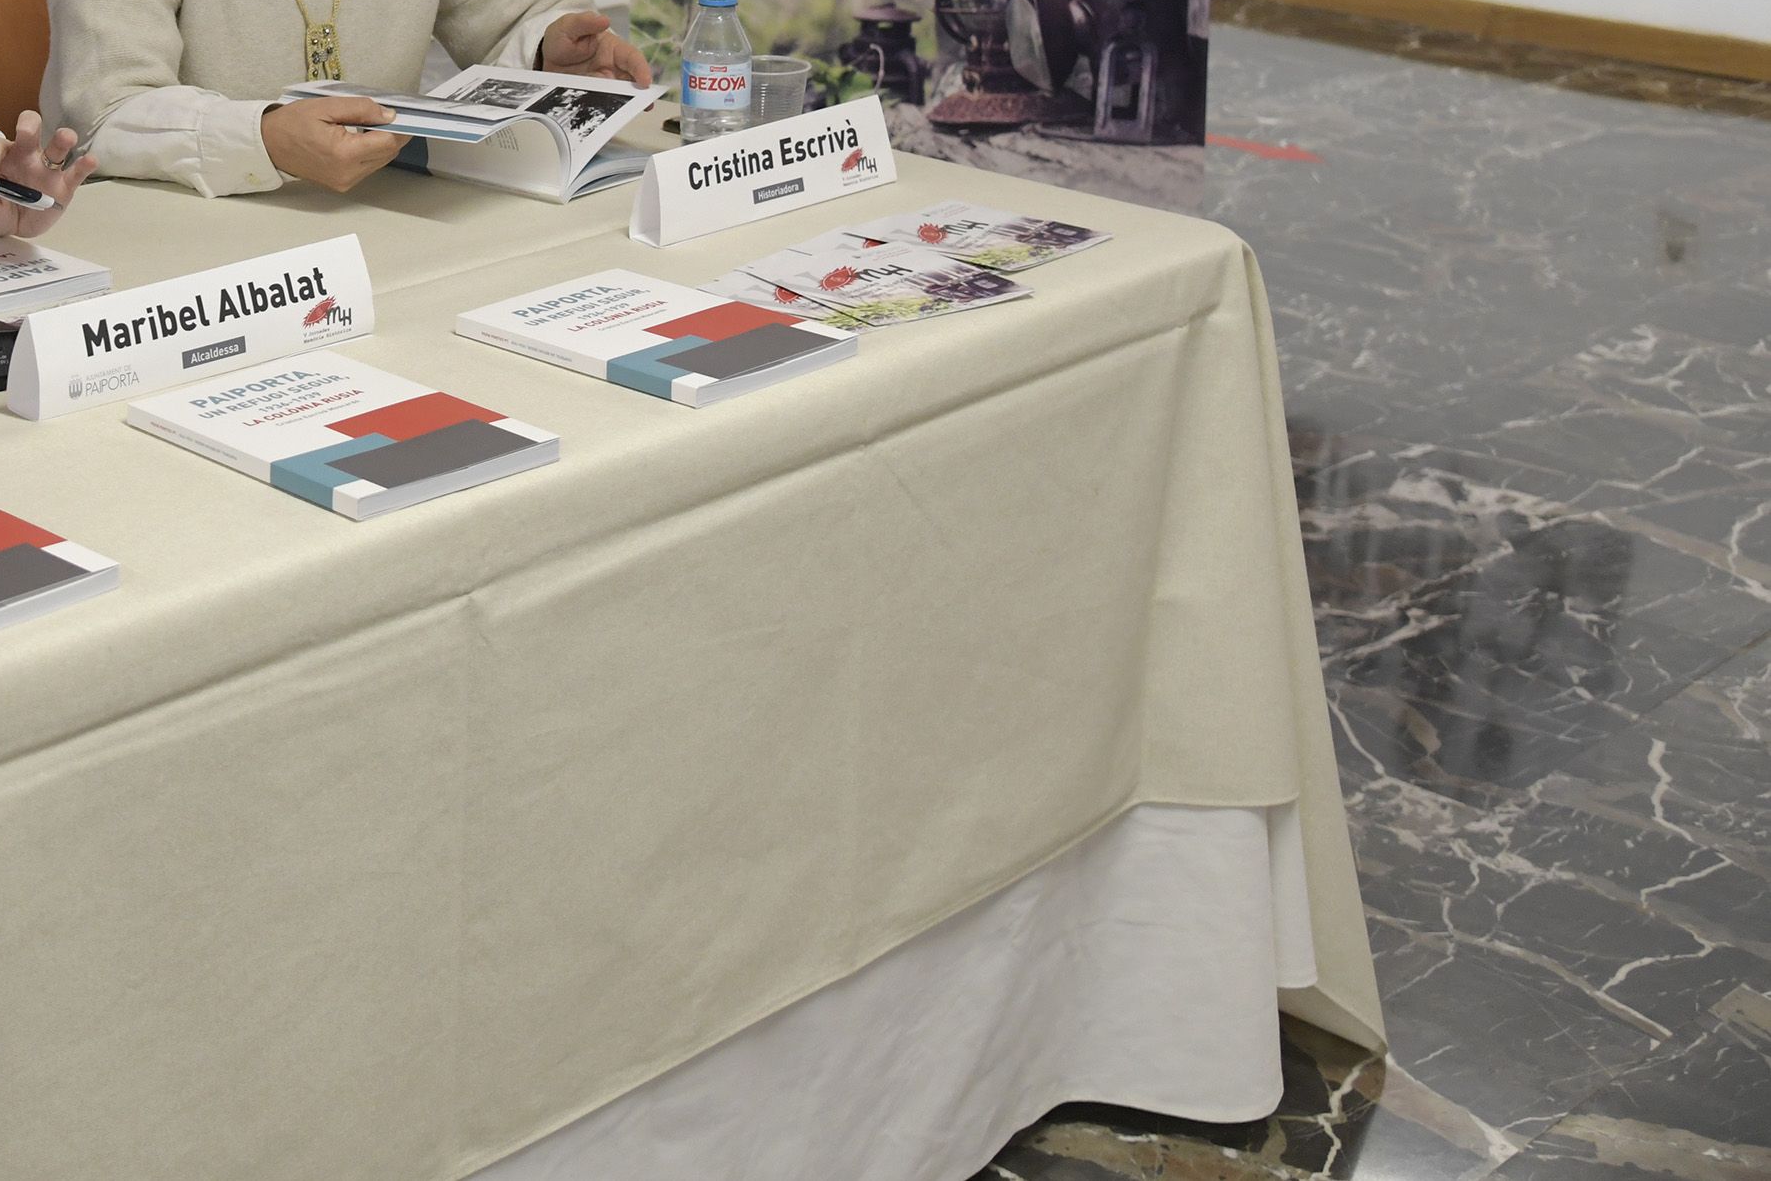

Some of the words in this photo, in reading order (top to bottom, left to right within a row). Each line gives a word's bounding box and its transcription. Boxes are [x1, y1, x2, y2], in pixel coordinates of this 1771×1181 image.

[688, 75, 746, 92] BEZOYA
[688, 149, 774, 191] Cristina
[779, 119, 859, 166] Escrivà
[757, 183, 800, 201] Historiadora
[81, 294, 211, 358] Maribel
[218, 267, 328, 323] Albalat
[190, 343, 240, 365] Alcaldessa
[85, 371, 140, 397] PAIPORTA
[189, 370, 321, 409] PAIPORTA,
[198, 408, 227, 419] UN
[226, 390, 290, 413] REFUGI
[258, 391, 322, 413] 1936-1939
[242, 418, 266, 427] LA
